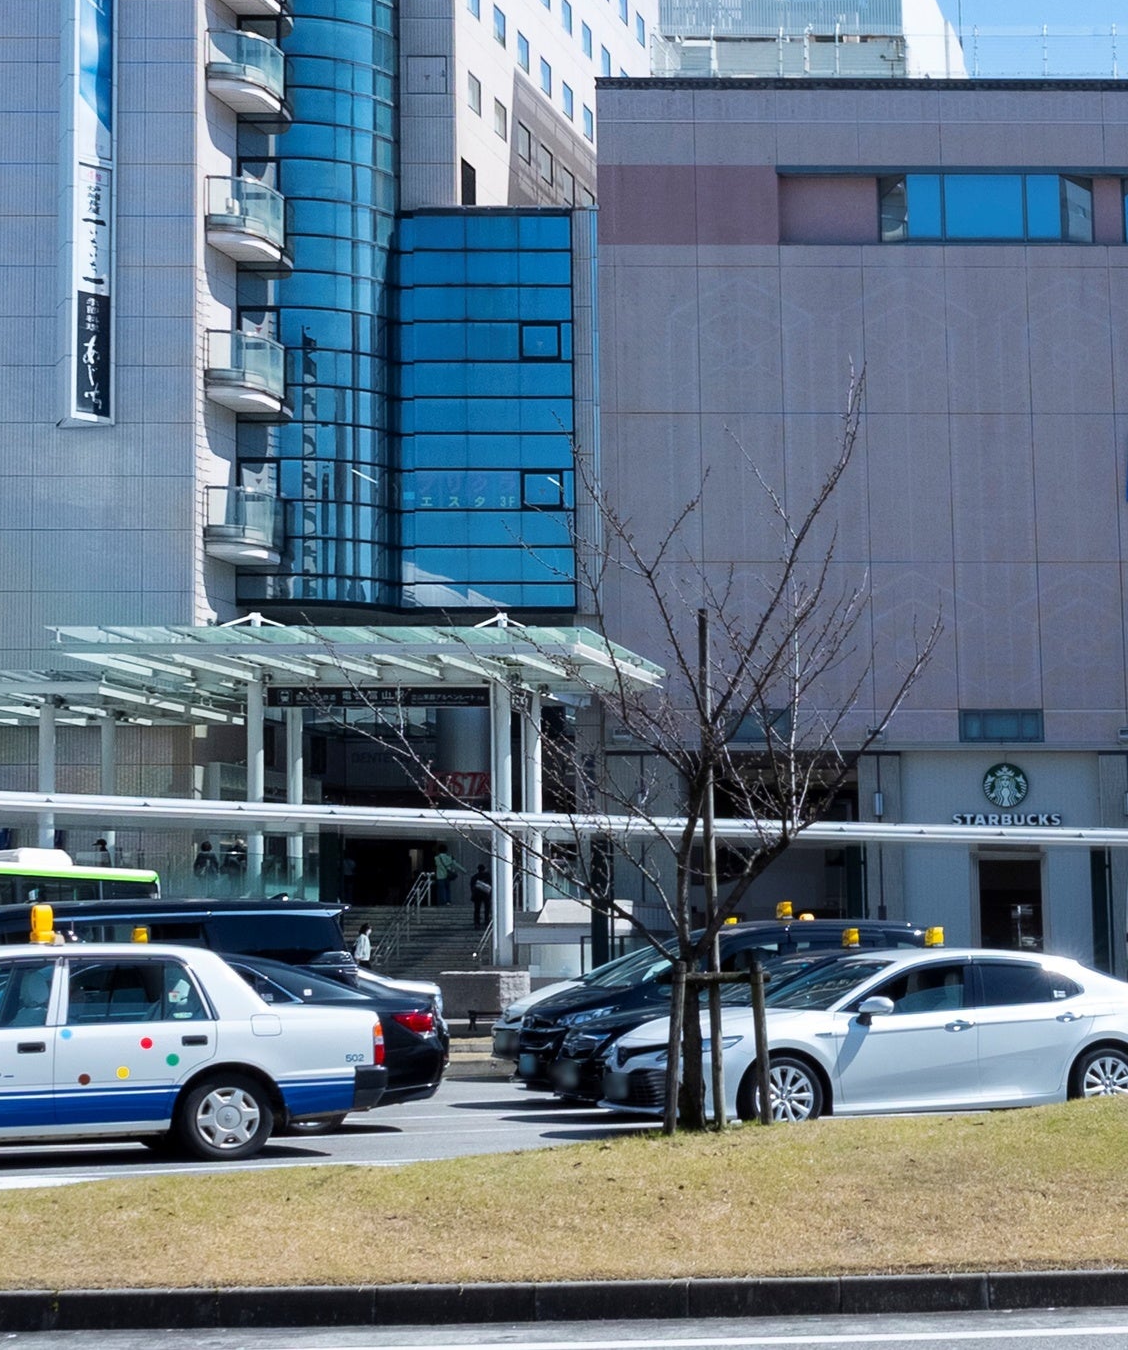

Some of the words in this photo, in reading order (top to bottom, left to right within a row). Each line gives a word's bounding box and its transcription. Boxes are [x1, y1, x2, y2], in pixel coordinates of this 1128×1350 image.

[420, 495, 486, 508] エスタ
[499, 495, 516, 508] 3F
[952, 813, 1062, 826] STARBUCKS
[345, 1053, 365, 1063] 502
